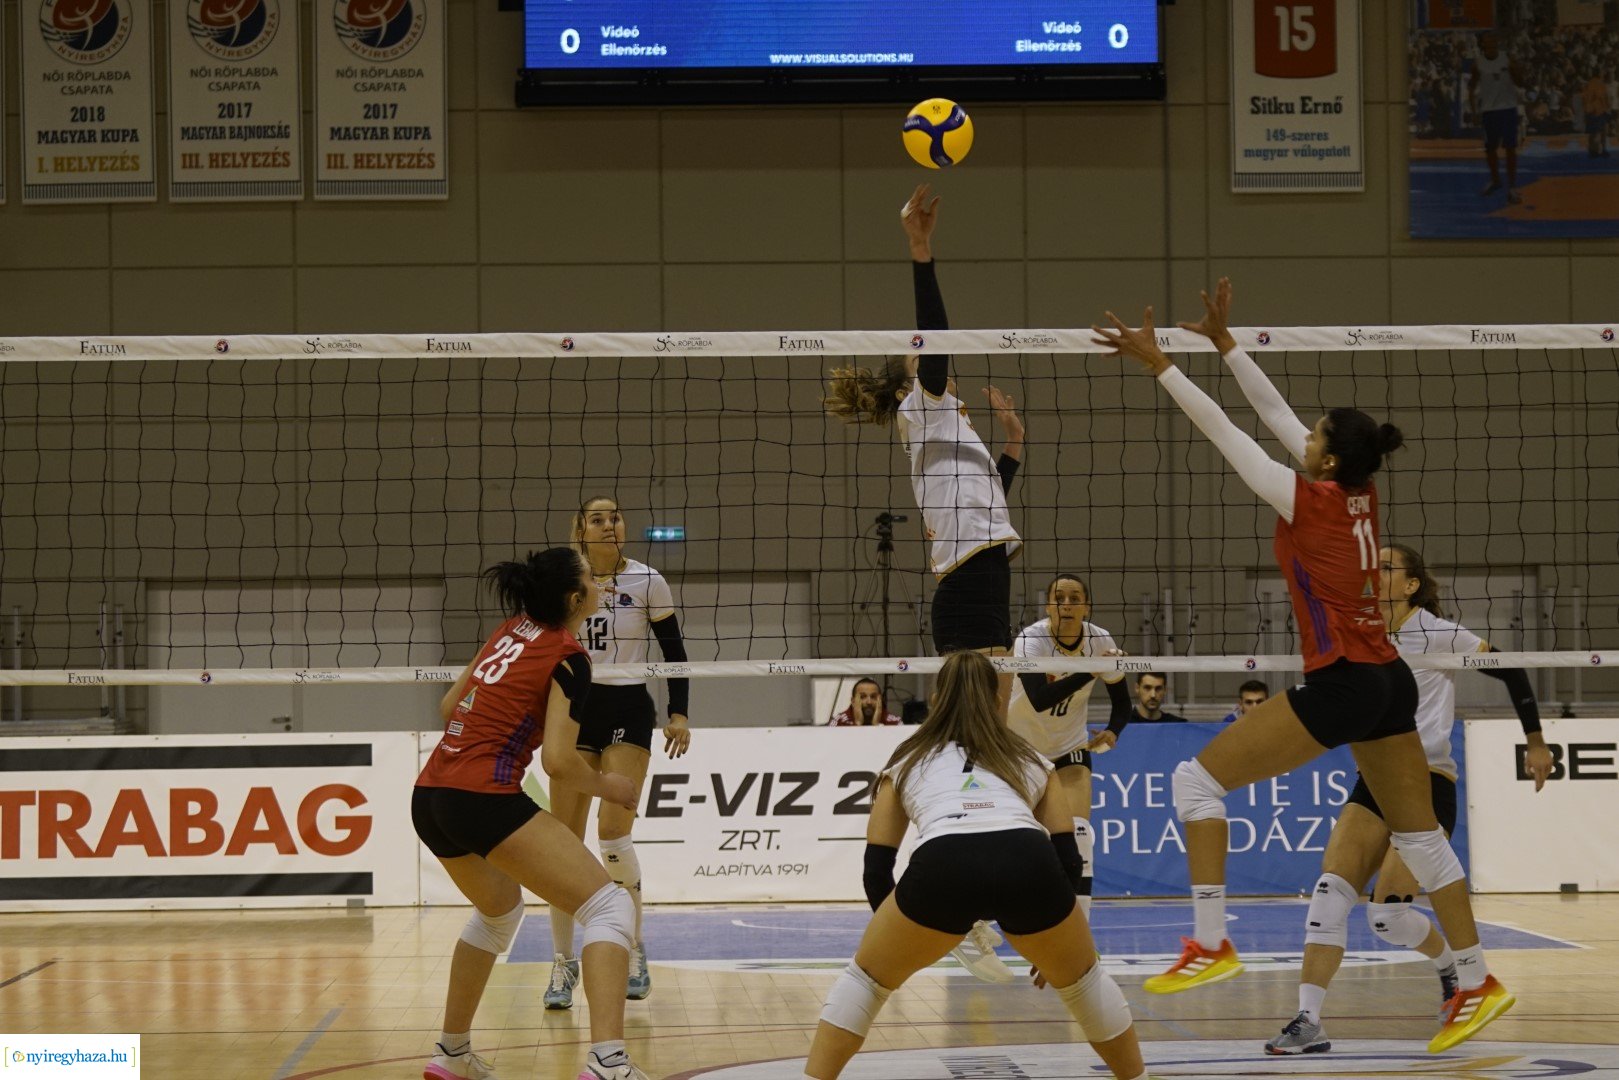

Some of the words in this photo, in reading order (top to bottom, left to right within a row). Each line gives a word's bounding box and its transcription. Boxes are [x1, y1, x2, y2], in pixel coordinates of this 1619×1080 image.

[601, 25, 640, 38] Videó
[1042, 21, 1082, 34] Videó
[1108, 23, 1129, 49] 0
[1274, 5, 1316, 52] 15
[560, 28, 581, 54] 0
[769, 53, 914, 64] WWW.VISUALSOLUTIONS.HU
[67, 69, 132, 82] RÖPLABDA
[215, 65, 279, 78] RÖPLABDA
[361, 66, 424, 79] RÖPLABDA
[60, 84, 114, 96] CSAPATA
[208, 81, 262, 92] CSAPATA
[353, 81, 408, 92] CSAPATA
[218, 102, 253, 119] 2017
[363, 103, 399, 119] 2017
[1250, 95, 1296, 115] Sitku
[1300, 95, 1344, 115] Ernő
[70, 106, 106, 123] 2018
[37, 129, 97, 145] MAGYAR
[101, 128, 140, 143] KUPA
[181, 125, 227, 140] MAGYAR
[229, 120, 291, 141] BAJNOKSÁG
[330, 126, 390, 141] MAGYAR
[393, 126, 433, 140] KUPA
[37, 156, 49, 173] I.
[53, 149, 140, 173] HELYEZÉS
[181, 153, 204, 170] III.
[208, 146, 291, 169] HELYEZÉS
[326, 153, 349, 170] III.
[353, 147, 436, 170] HELYEZÉS
[1244, 147, 1290, 161] magyar
[1292, 144, 1352, 160] válogatott
[1352, 519, 1378, 571] 11
[585, 617, 609, 651] 12
[473, 635, 525, 685] 23
[611, 727, 626, 744] 12
[1069, 749, 1084, 764] 10
[634, 771, 821, 818] E-VIZ
[0, 783, 374, 860] TRABAG
[718, 829, 782, 851] ZRT.
[693, 861, 774, 878] ALAPÍTVA
[777, 863, 810, 876] 1991
